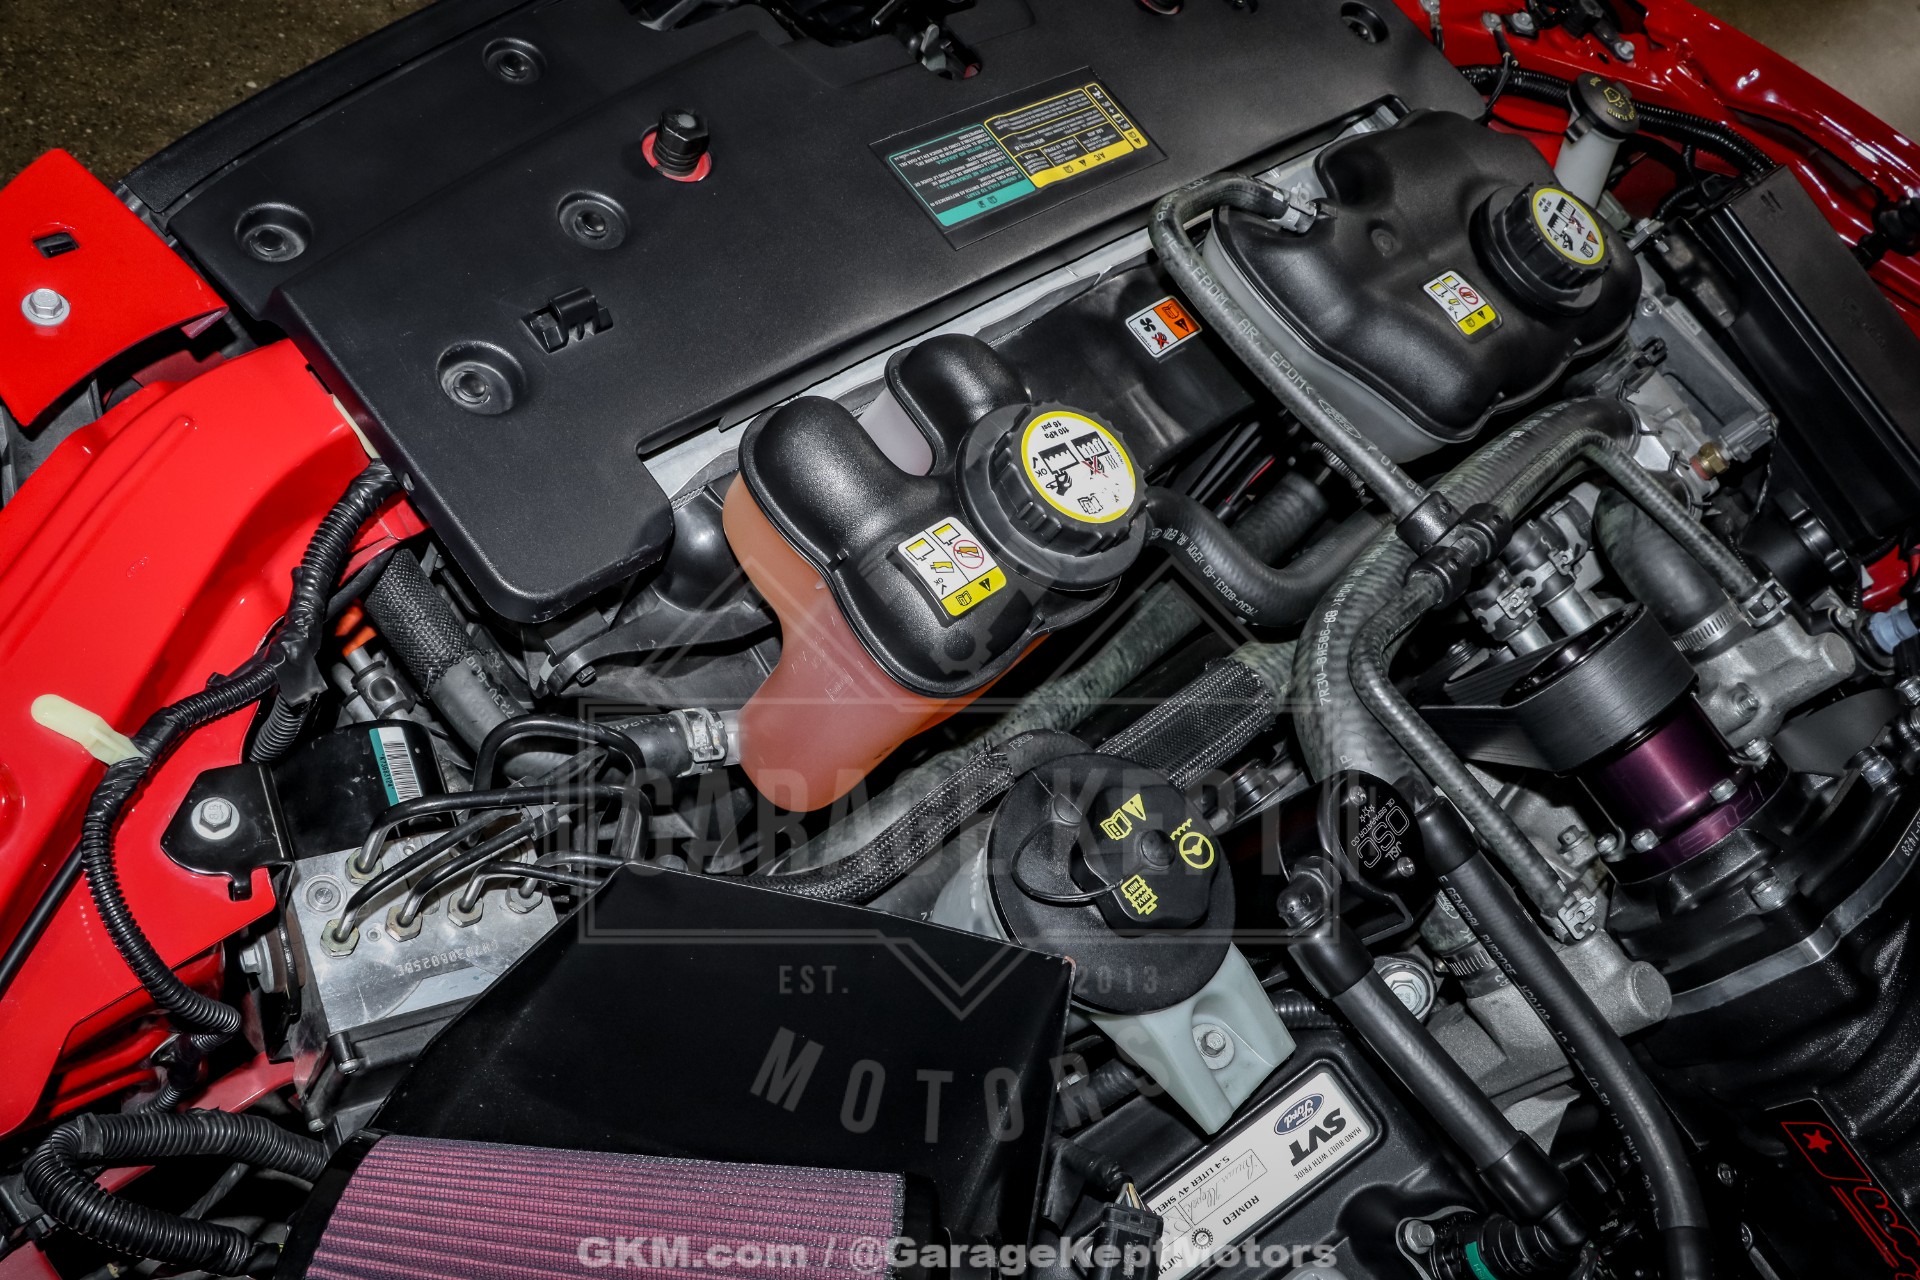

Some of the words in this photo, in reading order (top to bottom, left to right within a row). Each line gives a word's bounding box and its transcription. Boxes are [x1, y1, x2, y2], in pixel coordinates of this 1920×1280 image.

[1092, 152, 1106, 160] A/C
[1356, 805, 1409, 868] OSC
[1290, 1107, 1347, 1166] SVT
[1342, 1126, 1362, 1143] HAND
[1326, 1139, 1345, 1155] BUILT
[1212, 1154, 1230, 1170] 5.4
[1310, 1151, 1328, 1167] WITH
[1189, 1166, 1214, 1187] LITER
[1292, 1163, 1312, 1180] PRIDE
[1176, 1184, 1190, 1197] 4V
[1220, 1193, 1260, 1226] ROMEO
[1155, 1252, 1183, 1276] NICH
